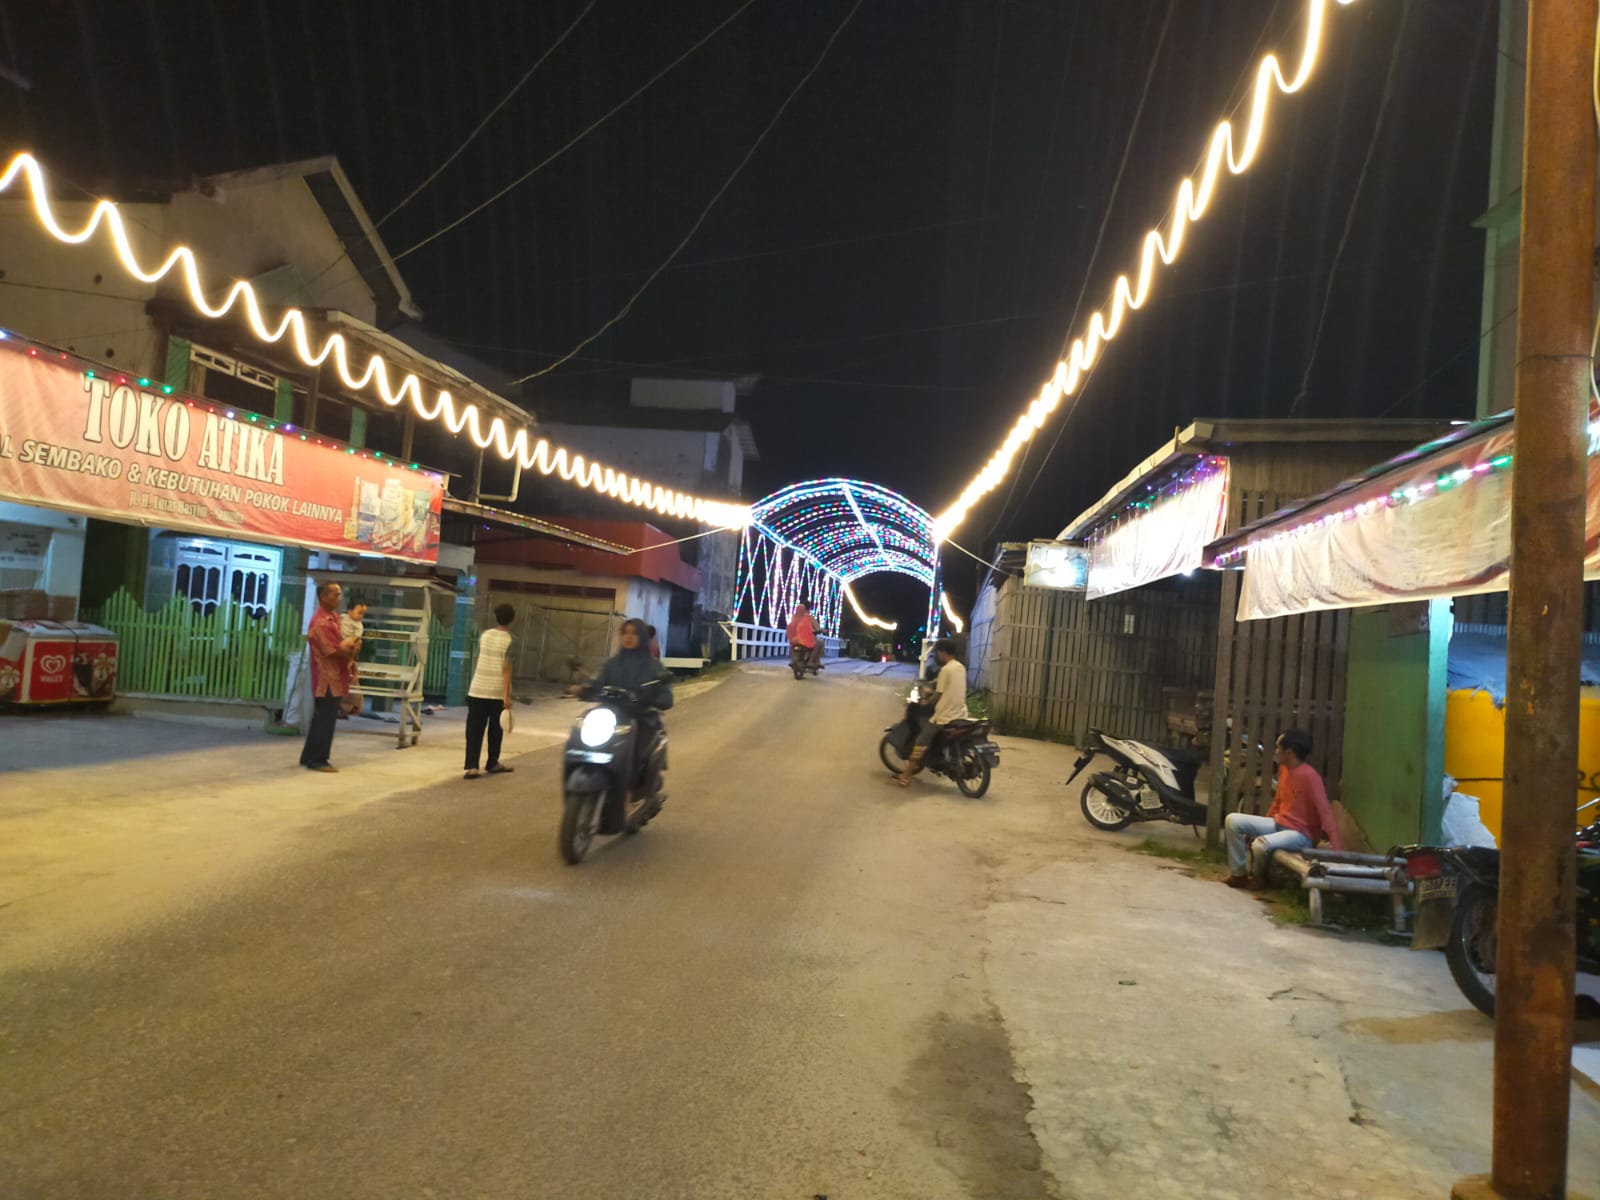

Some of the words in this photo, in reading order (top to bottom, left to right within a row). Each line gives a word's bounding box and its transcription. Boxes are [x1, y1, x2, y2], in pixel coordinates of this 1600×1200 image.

[83, 376, 190, 461] TOKO
[197, 412, 285, 486] ATIKA
[18, 438, 122, 479] SEMBAKO
[127, 463, 141, 484] &
[145, 466, 242, 504] KEBUTUHAN
[245, 489, 290, 513] POKOK
[292, 500, 343, 523] LAINNYA
